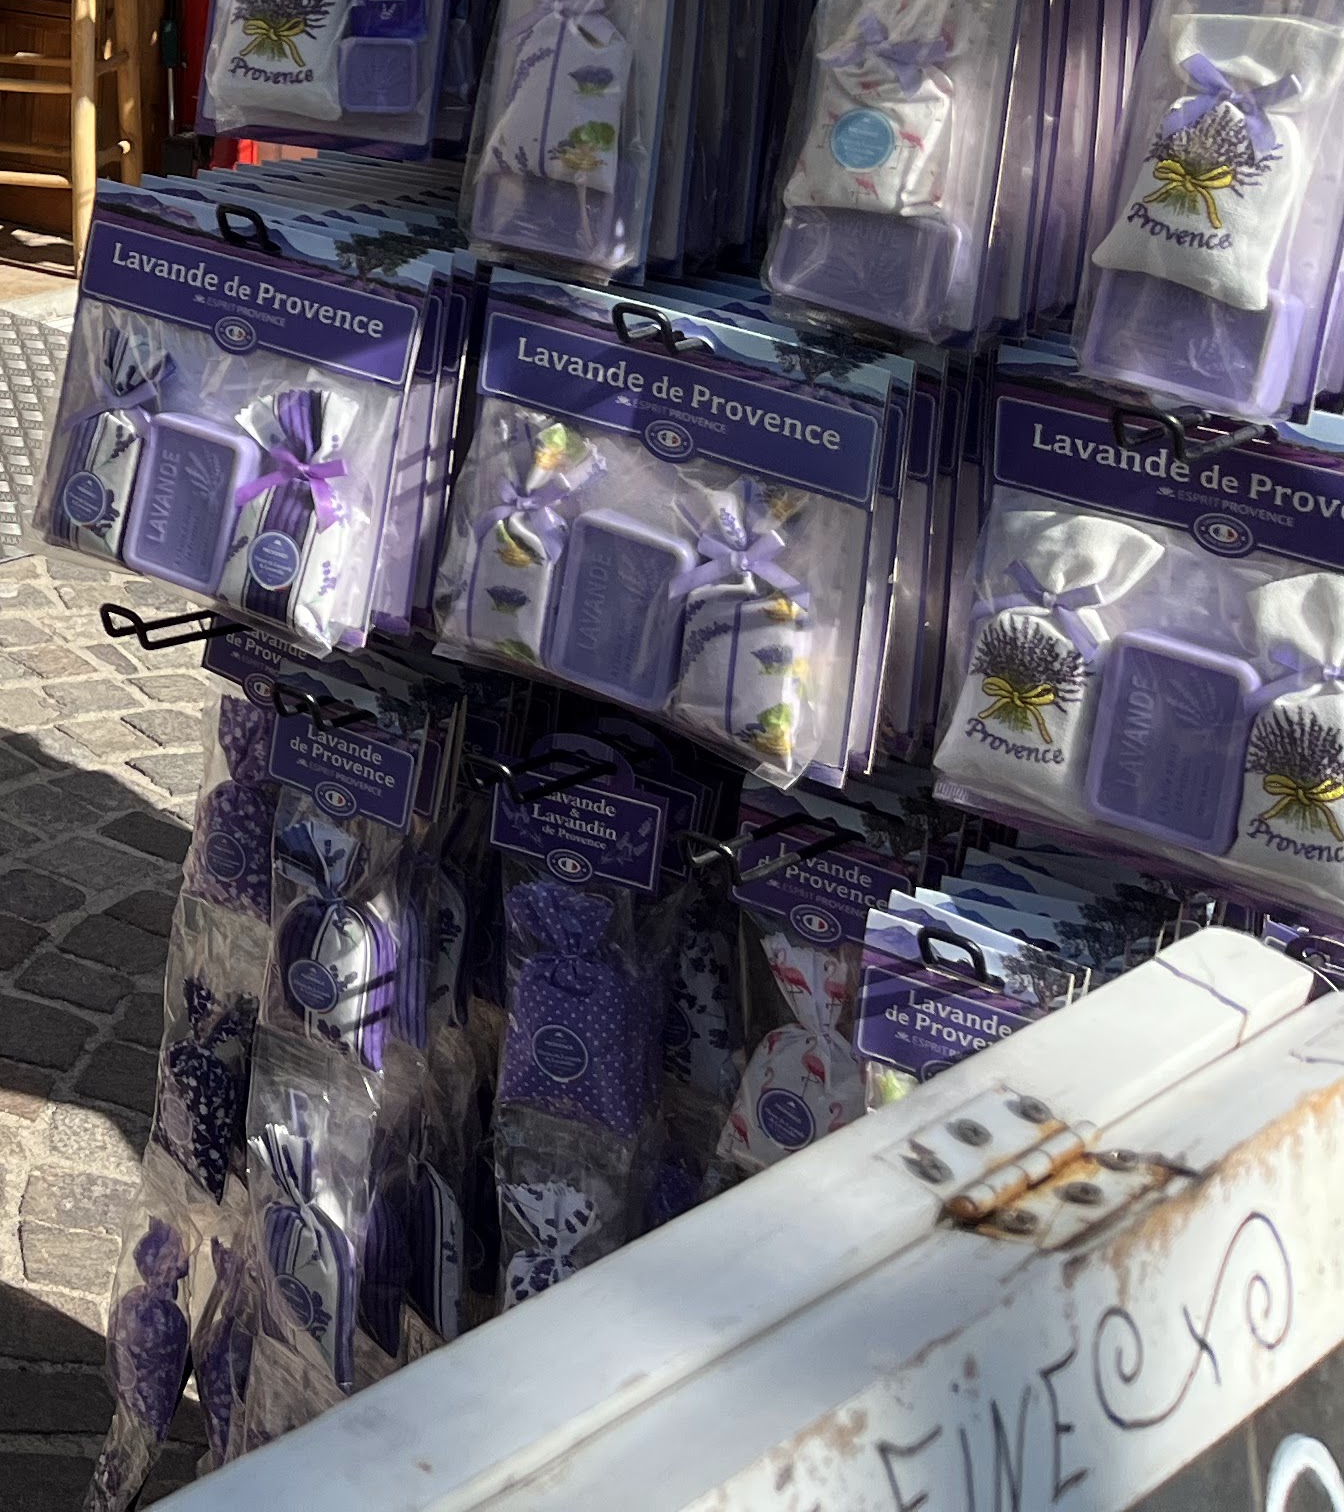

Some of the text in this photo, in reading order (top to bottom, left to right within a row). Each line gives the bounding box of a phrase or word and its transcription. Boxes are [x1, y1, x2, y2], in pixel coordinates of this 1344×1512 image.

[228, 55, 315, 85] Provence
[1127, 202, 1234, 252] Provence
[112, 242, 384, 340] Lavande de Provence
[518, 336, 842, 451] Lavande de Provence
[673, 406, 728, 436] PROVENCE
[1032, 423, 1190, 483] Lavande
[1200, 468, 1240, 494] de
[1220, 497, 1295, 529] PROVENCE
[289, 737, 395, 788] de Provence
[307, 723, 383, 765] Lavande
[964, 716, 1065, 765] Provence
[531, 802, 617, 841] Lavandin
[542, 825, 608, 851] de Provence
[784, 864, 889, 910] Provence
[884, 1003, 909, 1025] de
[909, 989, 1013, 1040] Lavande
